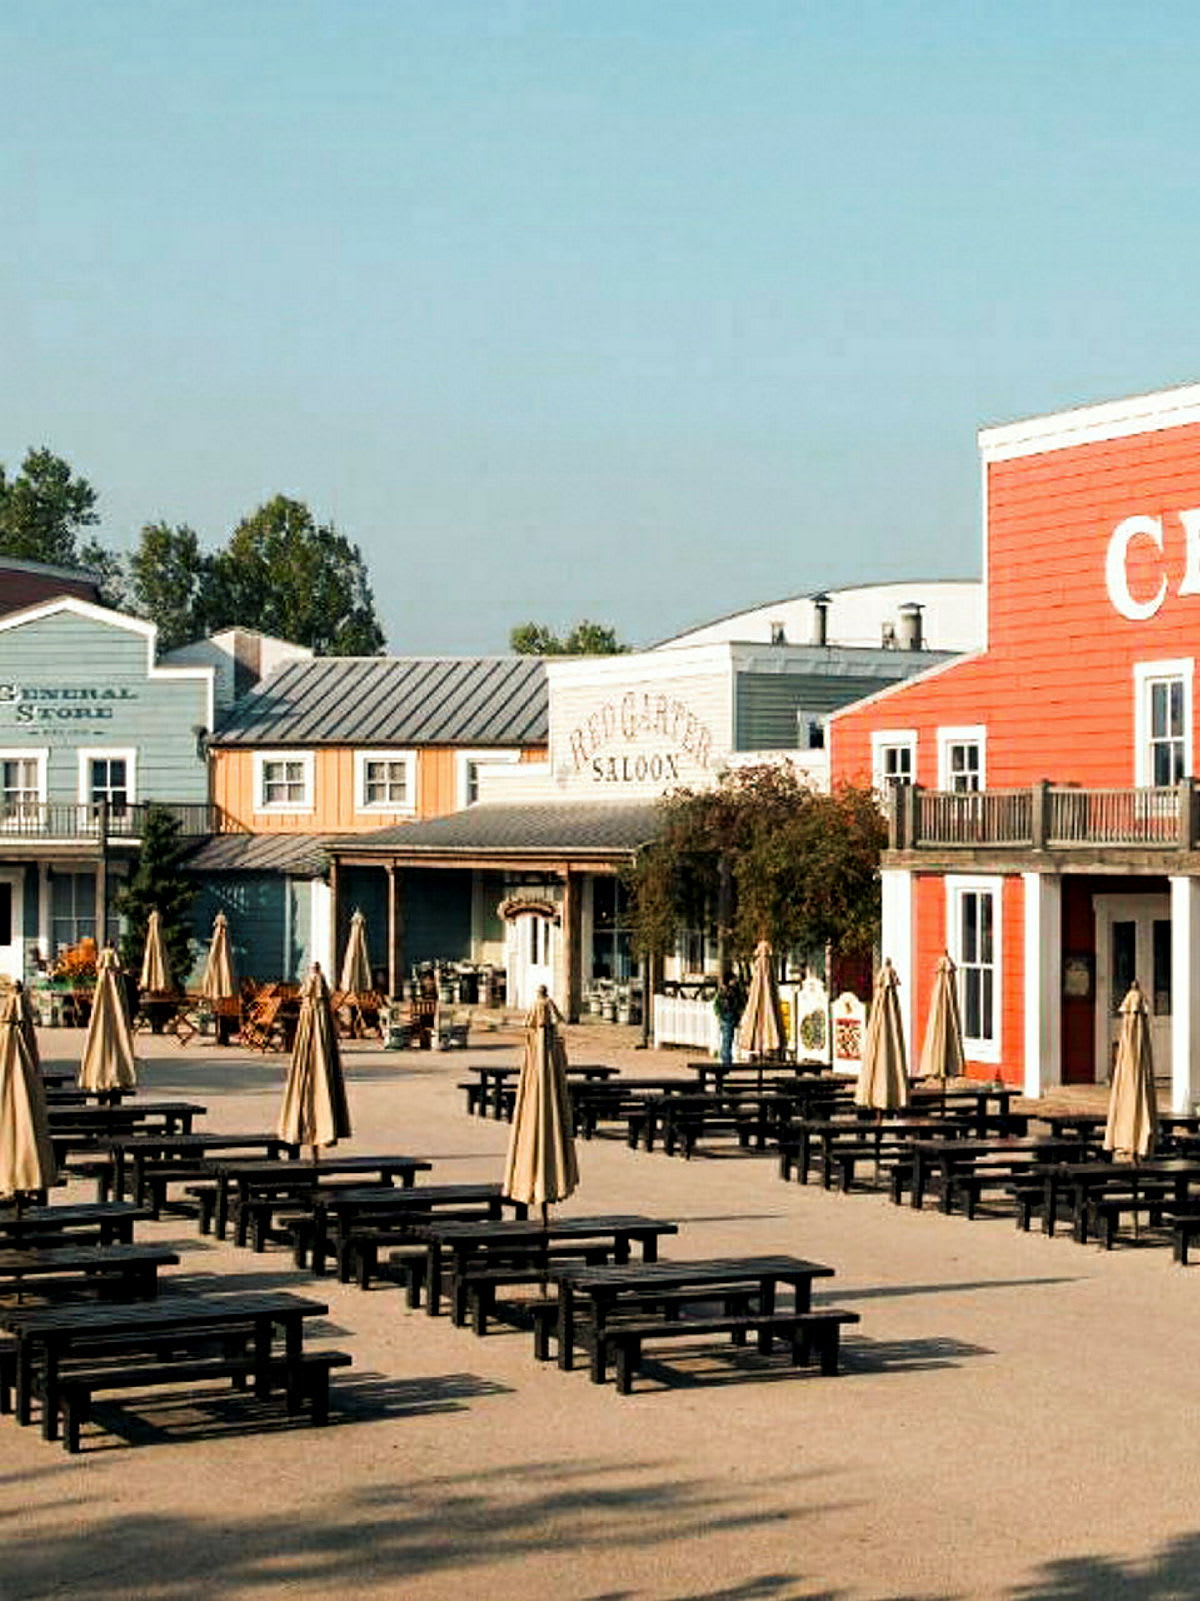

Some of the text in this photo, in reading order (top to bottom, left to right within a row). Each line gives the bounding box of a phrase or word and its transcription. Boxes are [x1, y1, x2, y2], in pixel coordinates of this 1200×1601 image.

[0, 684, 138, 701] GENERAL
[16, 703, 113, 722] STORE
[592, 754, 679, 782] SALOON
